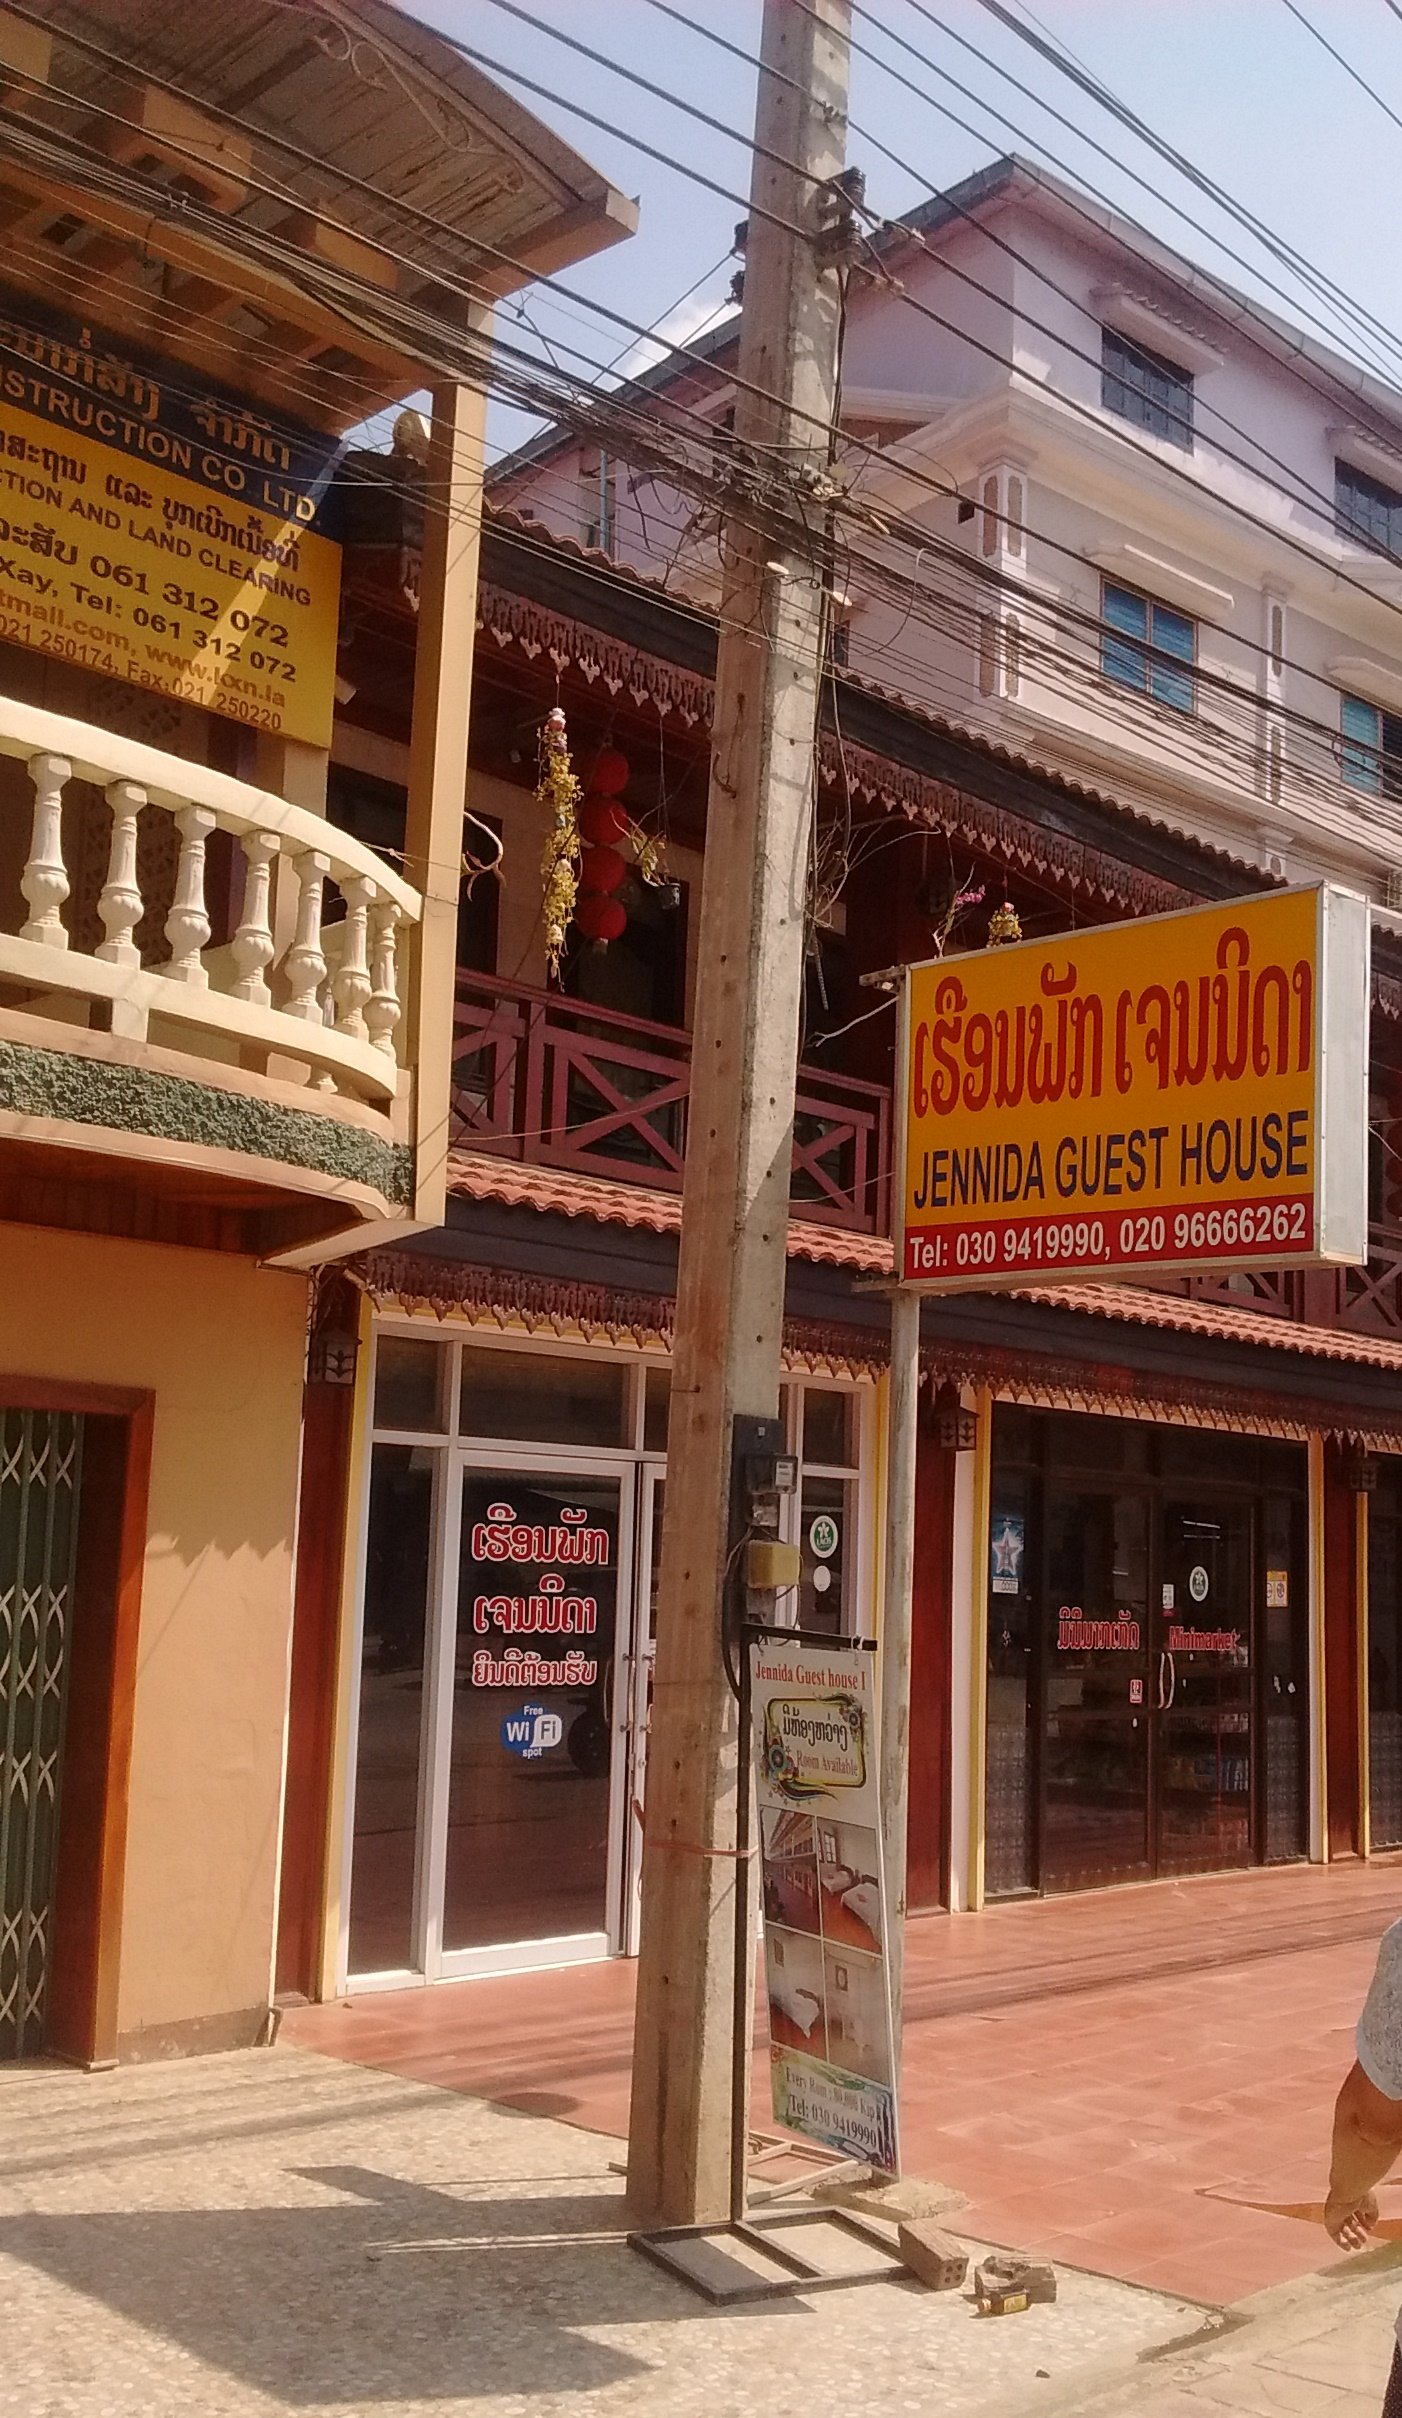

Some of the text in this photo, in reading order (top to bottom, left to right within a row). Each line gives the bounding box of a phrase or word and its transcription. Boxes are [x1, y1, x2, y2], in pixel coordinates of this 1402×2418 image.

[0, 369, 191, 469] STRUCTION
[0, 467, 62, 508] TION
[69, 497, 121, 530] AND
[129, 519, 192, 557] LAND
[105, 473, 153, 509] ແລະ
[90, 555, 149, 596] 061
[162, 582, 219, 621] 312
[230, 609, 289, 648] 072
[70, 581, 122, 619] Tel:
[133, 607, 181, 640] 061
[193, 629, 241, 662] 312
[250, 651, 296, 683] 072
[216, 691, 281, 730] 250220
[914, 1110, 1309, 1209] JENNIDA GUEST HOUSE
[910, 1202, 1307, 1269] Tel: 030 9419990, 020 96666262
[1168, 1625, 1239, 1651] Minimarket
[755, 1661, 794, 1682] Jennida
[796, 1664, 825, 1686] Guest
[828, 1667, 858, 1690] house
[523, 1704, 544, 1716] Free
[522, 1747, 543, 1760] spot
[796, 1750, 858, 1777] Room Available
[789, 2093, 809, 2121] Tel:
[811, 2103, 830, 2125] 030
[832, 2112, 877, 2148] 9419990
